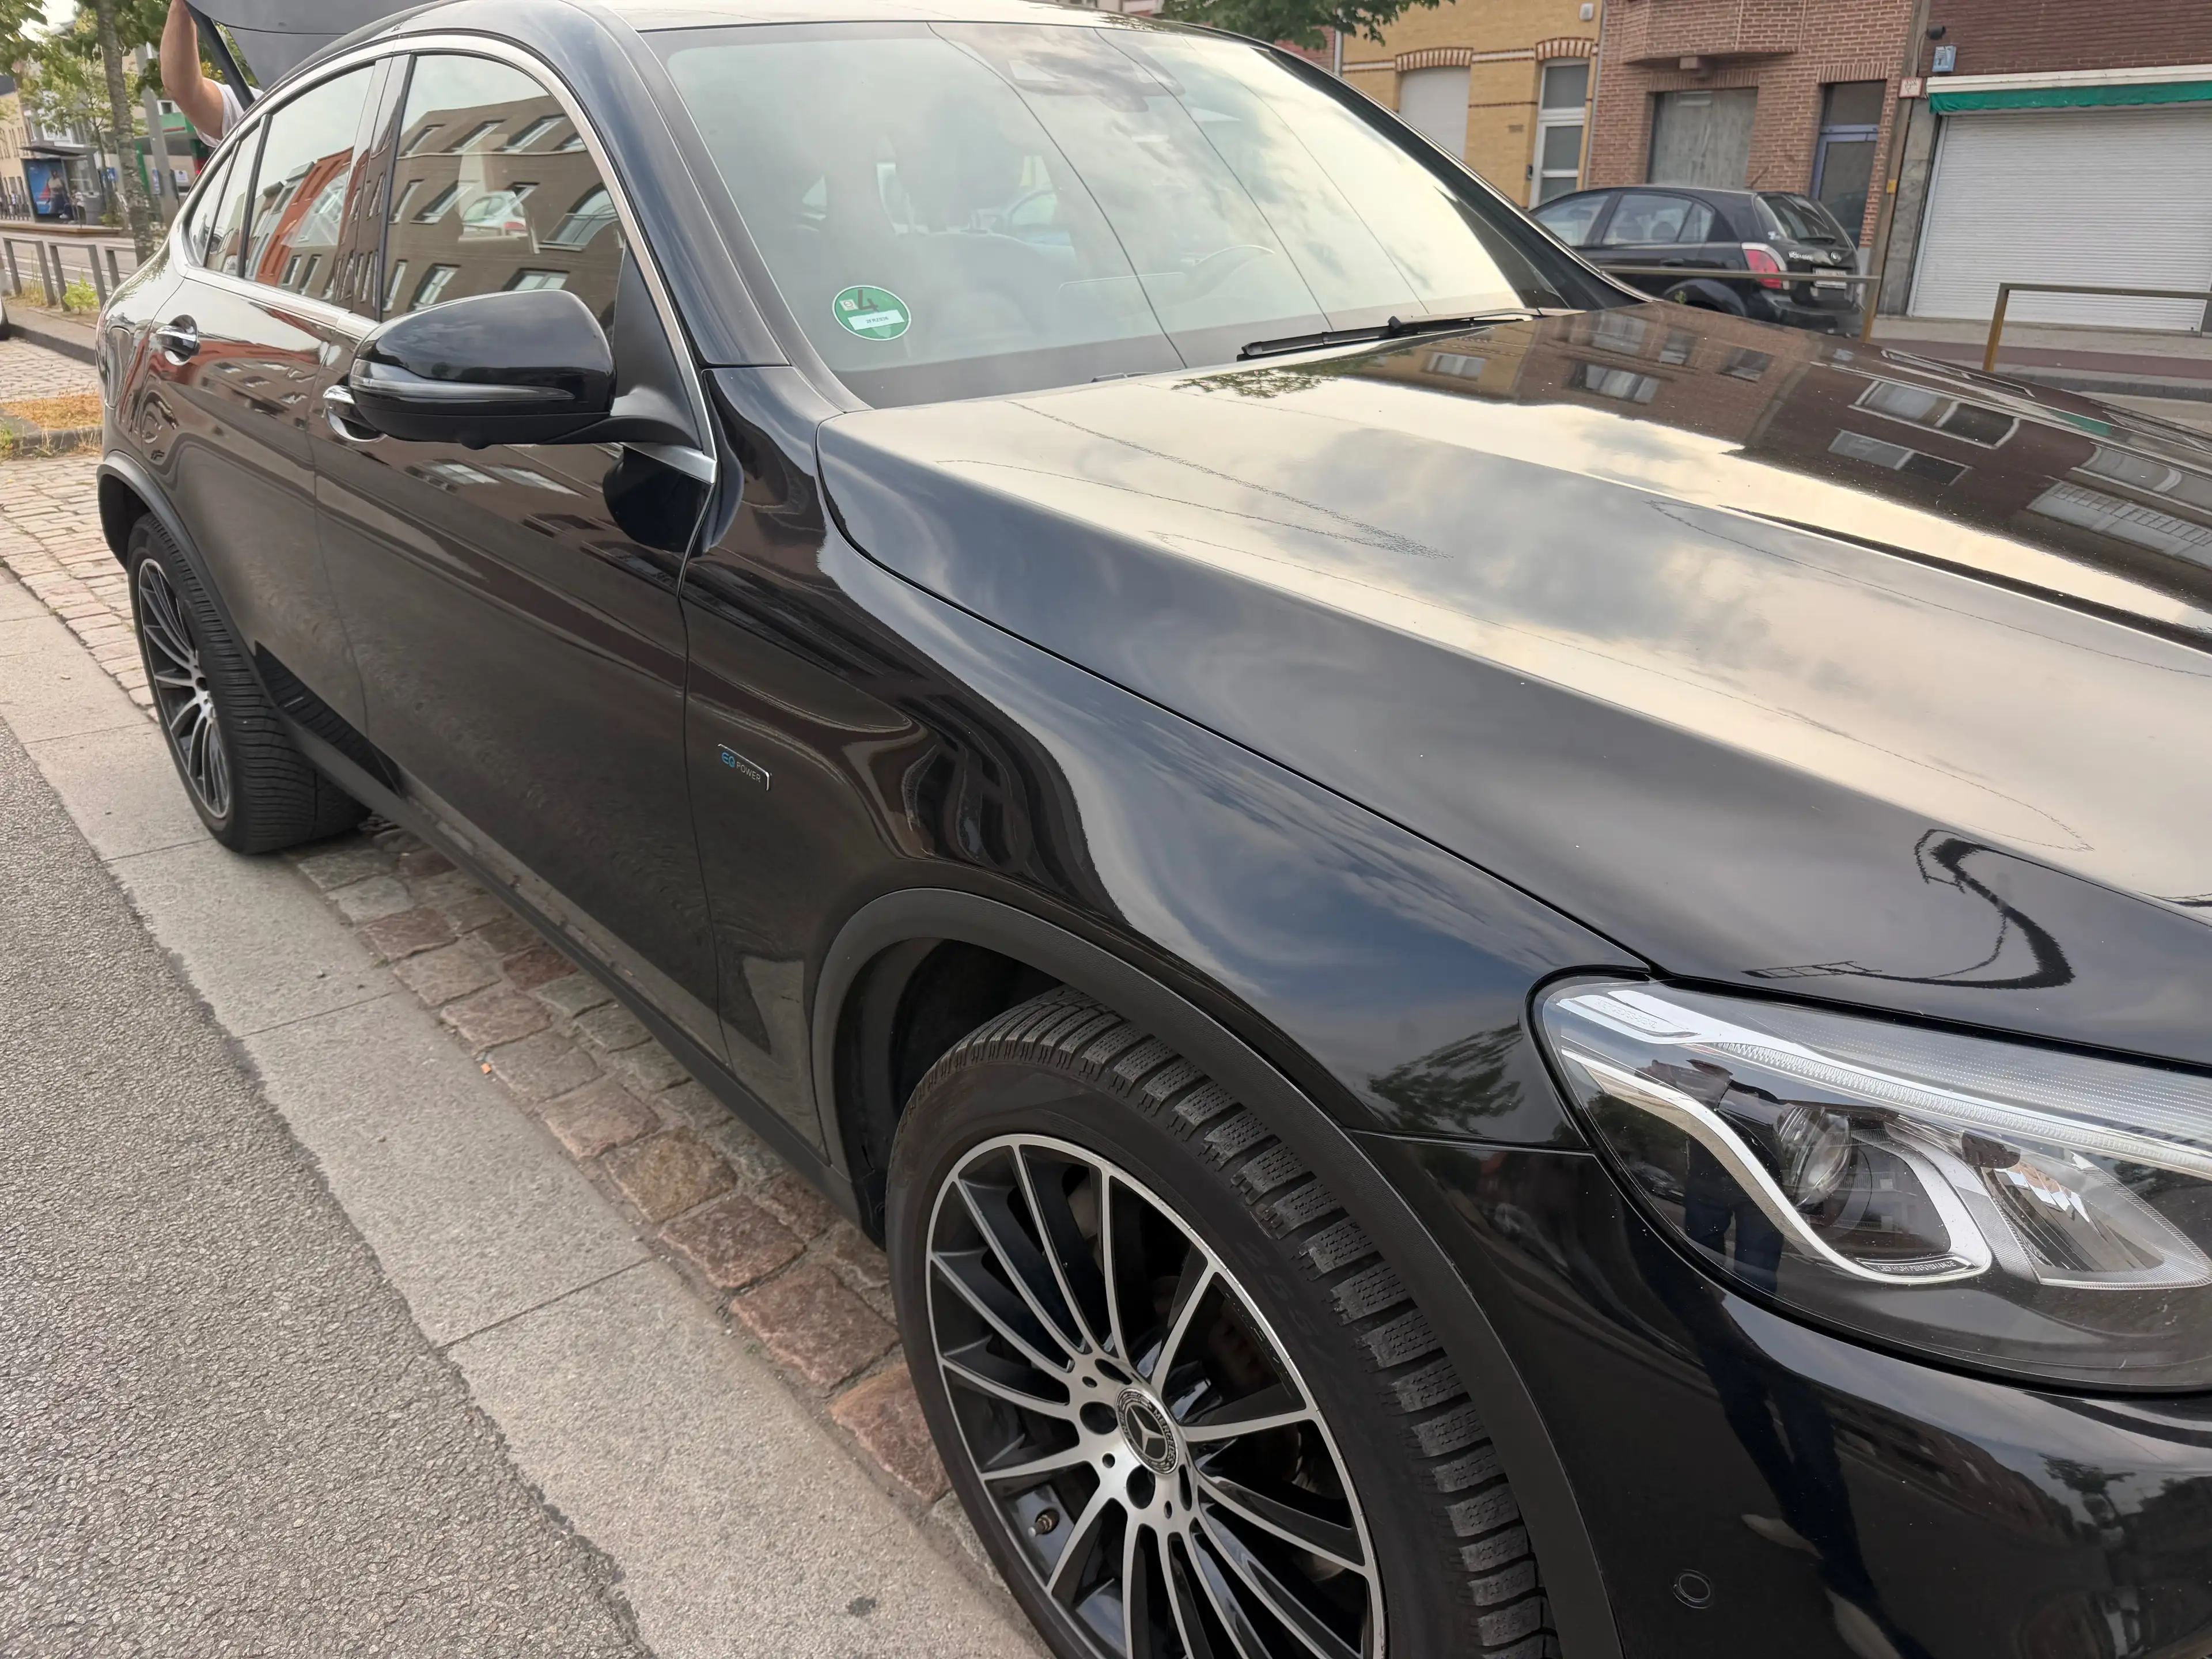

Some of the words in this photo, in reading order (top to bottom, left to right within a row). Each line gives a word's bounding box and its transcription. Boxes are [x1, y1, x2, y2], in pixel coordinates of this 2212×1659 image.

[858, 289, 879, 312] 4
[736, 761, 761, 783] POWER
[1909, 1260, 1957, 1272] PERFORMANCE
[1153, 1410, 1176, 1464] MERCEDES
